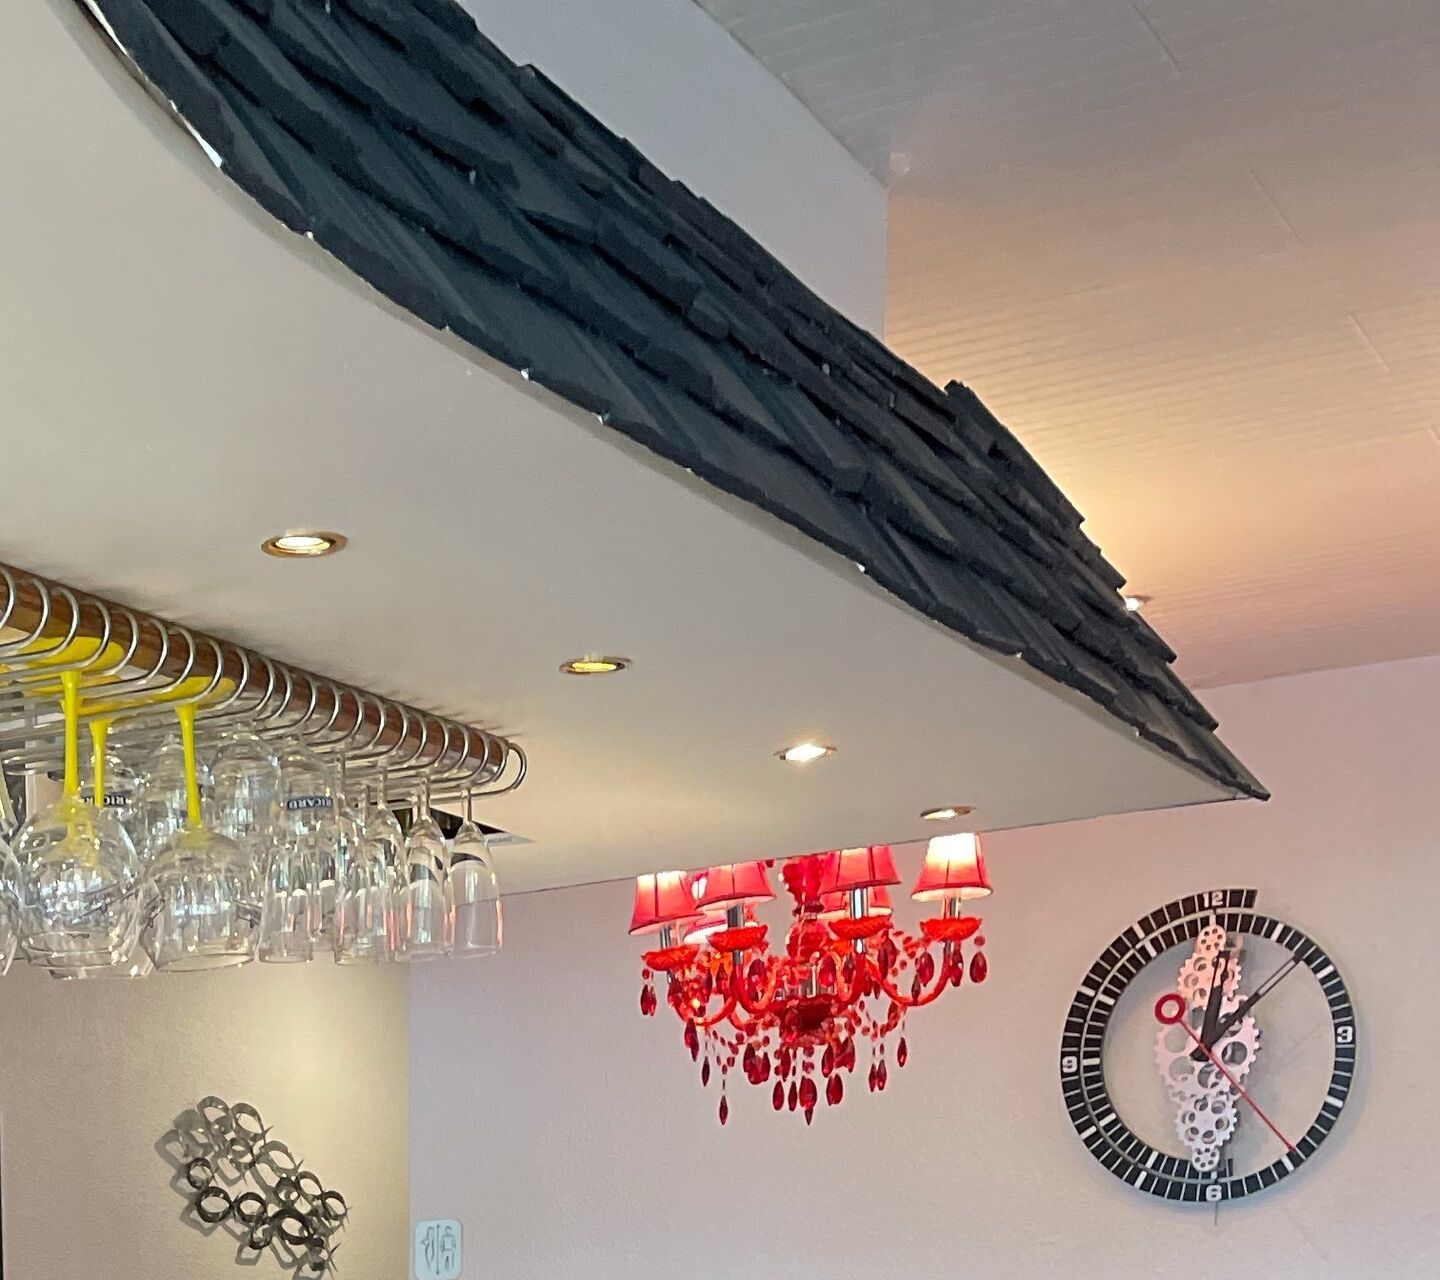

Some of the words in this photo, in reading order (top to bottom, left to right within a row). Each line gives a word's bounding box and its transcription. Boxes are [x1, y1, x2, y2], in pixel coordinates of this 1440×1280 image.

[288, 796, 333, 810] RICARD
[1202, 891, 1224, 908] 12
[1336, 1025, 1353, 1043] 3
[1061, 1055, 1078, 1073] 9
